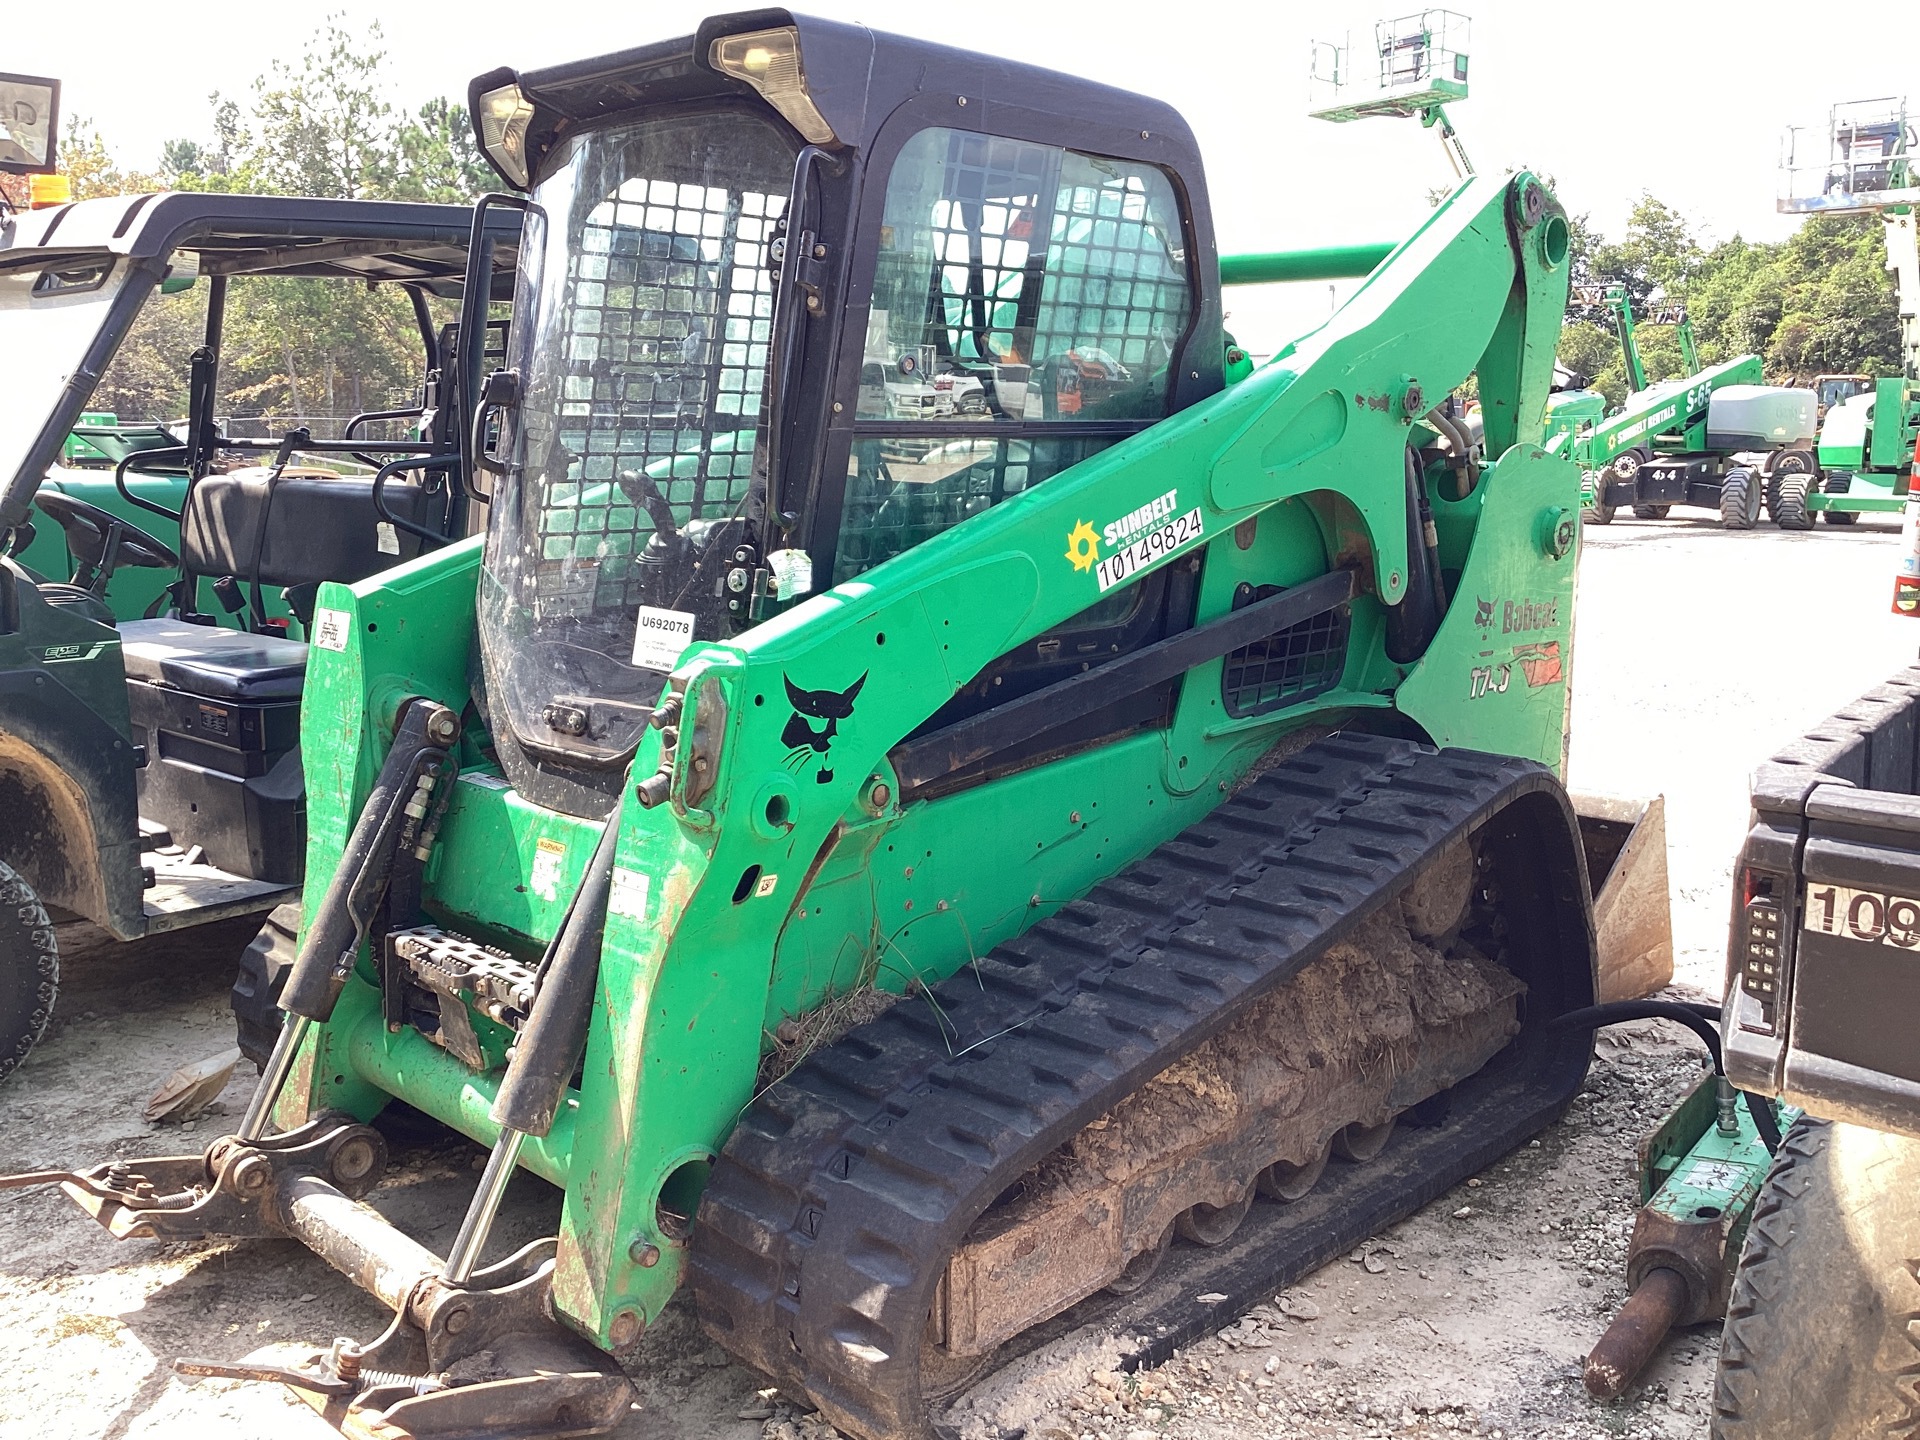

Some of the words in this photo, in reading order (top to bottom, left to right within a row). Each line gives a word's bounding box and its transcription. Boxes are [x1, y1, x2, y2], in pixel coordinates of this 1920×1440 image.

[1685, 380, 1712, 413] S-65
[1103, 488, 1177, 547] SUNBELT
[1099, 508, 1201, 587] 10149824
[642, 616, 689, 634] U692078
[1502, 595, 1558, 634] Bobcat
[45, 645, 80, 658] EPS
